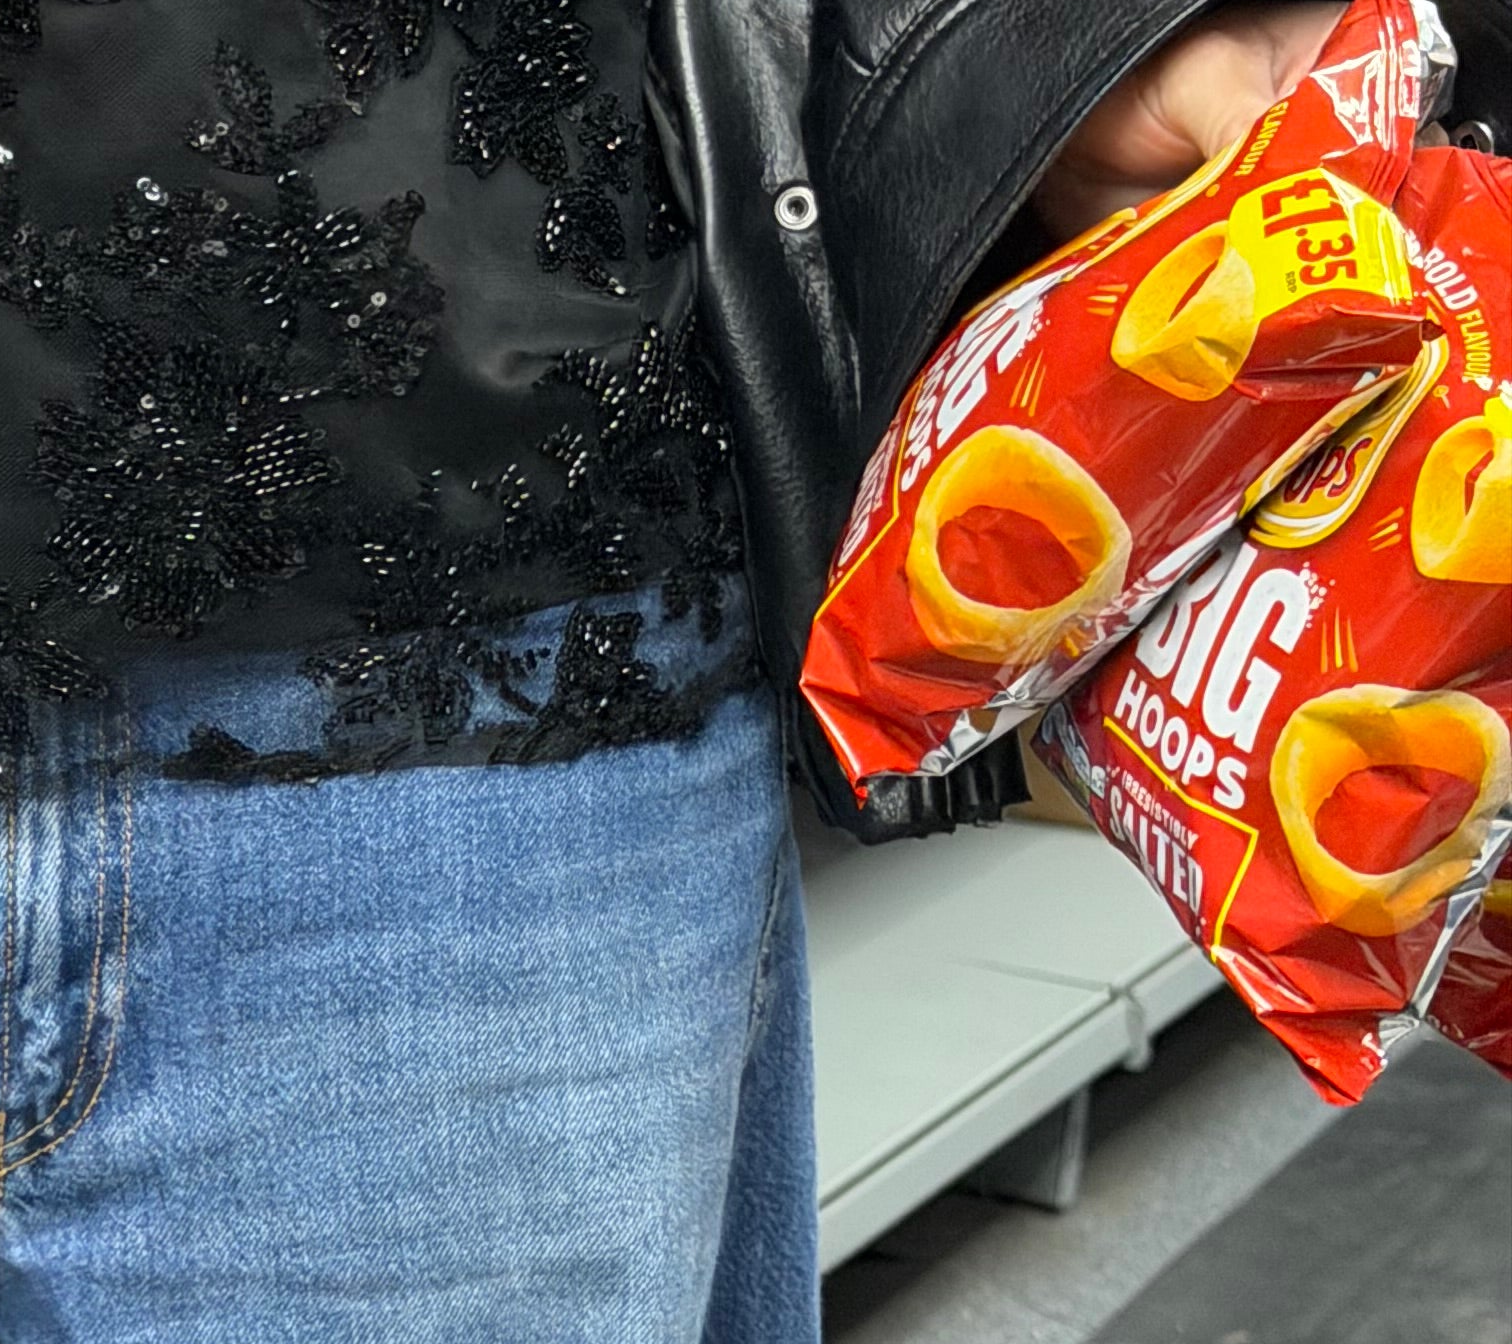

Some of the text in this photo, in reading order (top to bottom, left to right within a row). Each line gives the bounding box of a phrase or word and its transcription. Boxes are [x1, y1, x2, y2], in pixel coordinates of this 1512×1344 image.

[1234, 100, 1289, 177] FLAVOUR
[1261, 177, 1358, 286] £1.35
[1135, 542, 1311, 753] BIG
[1114, 668, 1248, 810] HOOPS
[1108, 783, 1204, 915] SALTED
[1121, 768, 1200, 853] IRRESISTIBLY
